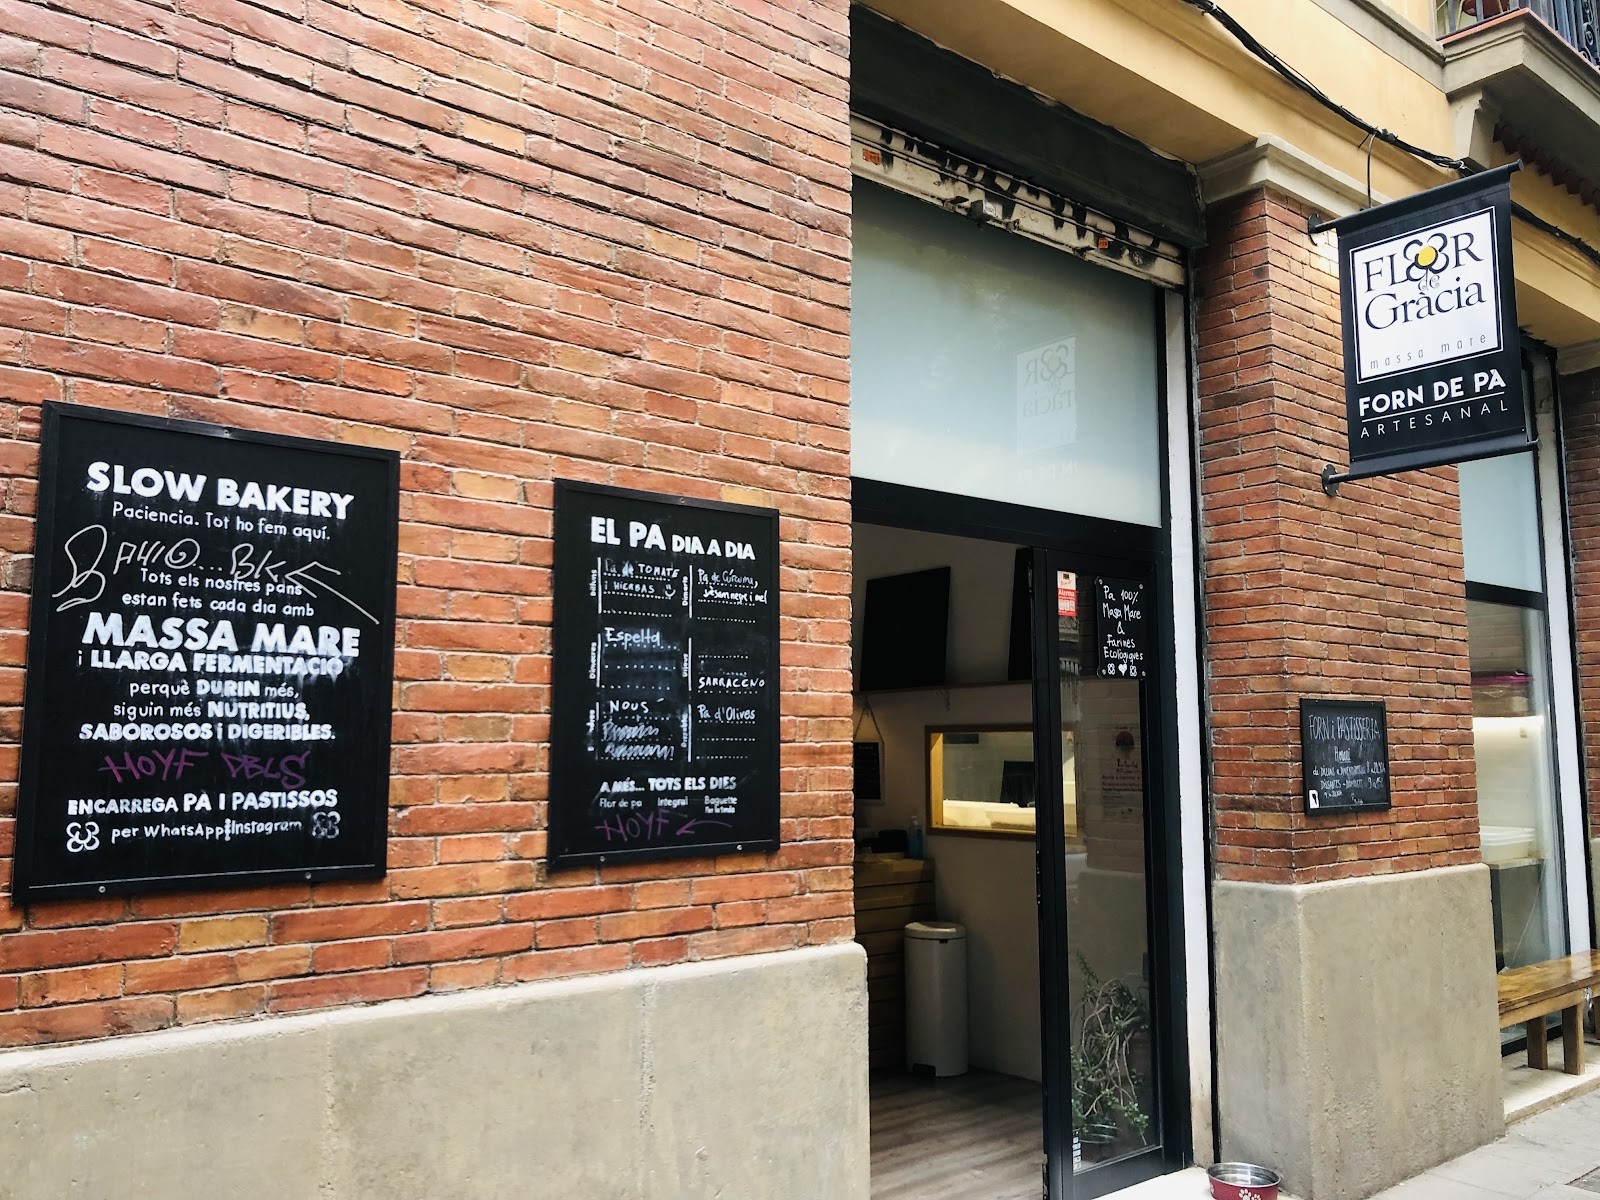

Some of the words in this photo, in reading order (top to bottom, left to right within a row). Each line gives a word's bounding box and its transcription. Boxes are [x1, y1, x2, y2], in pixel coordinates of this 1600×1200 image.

[1418, 269, 1441, 291] de
[1364, 276, 1487, 330] Gràcia
[1370, 348, 1424, 370] massa
[1440, 333, 1487, 353] mare
[1359, 385, 1424, 417] FORN
[1433, 376, 1464, 402] DE
[1360, 400, 1508, 438] ARTESANAL
[86, 461, 207, 503] SLOW
[216, 477, 355, 520] BAKERY
[112, 501, 200, 527] Paciencia.
[206, 512, 230, 530] Tot
[235, 515, 255, 532] ho
[257, 518, 287, 537] fem
[292, 524, 331, 542] aquí.
[590, 516, 621, 546] EL
[629, 521, 666, 551] PA
[671, 535, 705, 555] DIA
[706, 538, 722, 557] A
[724, 540, 756, 561] DIA
[140, 567, 172, 586] Tots
[177, 570, 200, 588] els
[205, 576, 261, 593] nostres
[265, 580, 303, 597] pans
[638, 563, 680, 578] TOMATE
[122, 592, 167, 609] estan
[171, 592, 203, 610] fets
[209, 597, 247, 613] cada
[282, 601, 315, 617] amb
[1103, 585, 1116, 601] Pa
[1121, 589, 1138, 605] 100%
[1124, 604, 1141, 621] Mare
[82, 611, 239, 652] MASSA
[250, 623, 361, 657] MARE
[604, 627, 660, 650] Espelta
[1117, 620, 1125, 635] &
[77, 651, 83, 666] i
[90, 650, 187, 673] LLARGA
[129, 679, 190, 698] perquè
[196, 679, 260, 697] DURIN
[264, 682, 300, 699] més,
[113, 703, 164, 720] siguin
[169, 702, 202, 718] més
[207, 700, 310, 721] NUTRITIUS,
[697, 704, 711, 719] Pa
[78, 723, 213, 741] SABOROSOS
[216, 723, 223, 739] i
[227, 723, 336, 741] DIGERIBLES.
[1308, 714, 1330, 742] FORN
[600, 781, 611, 793] A
[648, 777, 681, 791] TOTS
[684, 777, 706, 791] ELS
[709, 776, 736, 790] DIES
[67, 796, 179, 816] ENCARREGA
[218, 793, 226, 810] I
[231, 789, 338, 811] PASTISSOS
[599, 798, 616, 808] Flor
[618, 798, 629, 807] de
[112, 825, 139, 844] per
